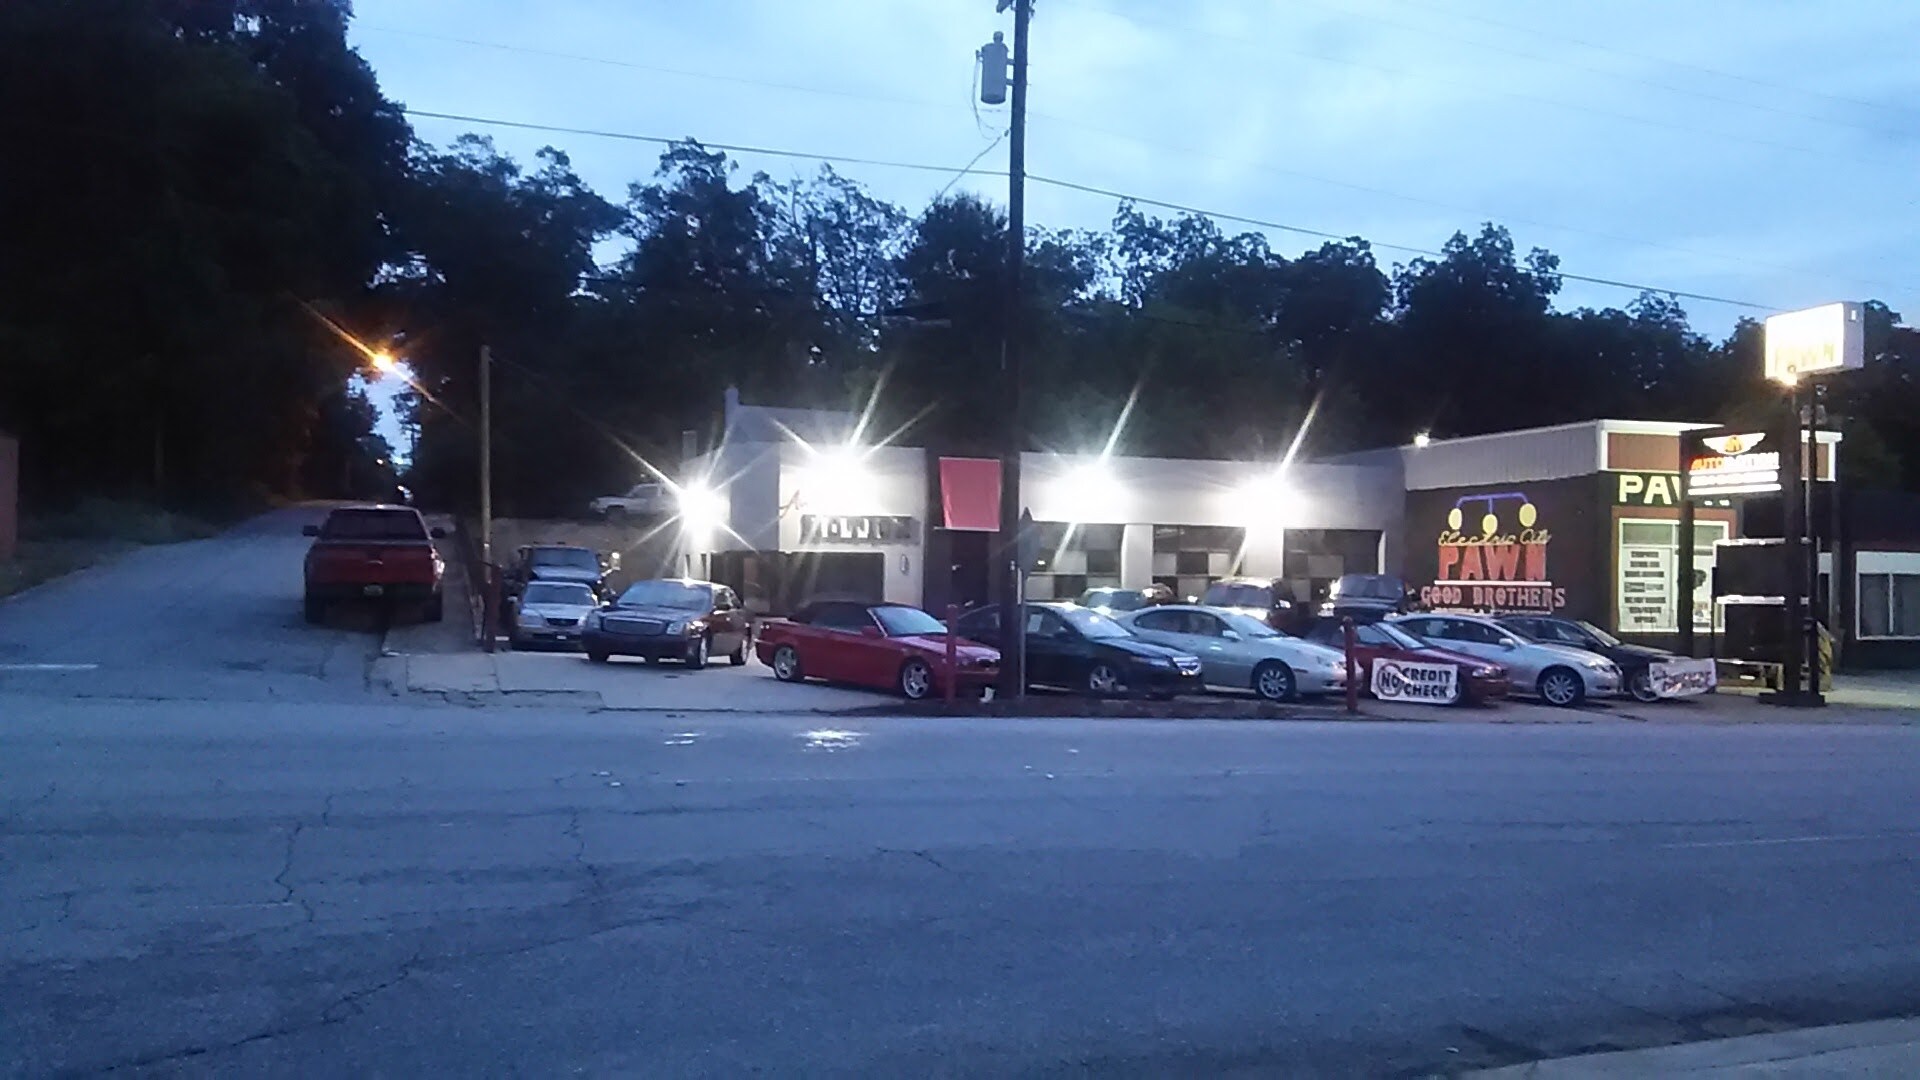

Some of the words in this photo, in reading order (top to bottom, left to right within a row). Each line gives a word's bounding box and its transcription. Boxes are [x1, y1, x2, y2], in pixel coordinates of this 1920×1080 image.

[1438, 544, 1547, 581] PAWN
[1421, 586, 1462, 606] GOOD
[1473, 587, 1566, 611] BROTHERS
[1381, 672, 1400, 688] NO
[1402, 667, 1452, 683] CREDIT
[1403, 684, 1447, 698] CHECK
